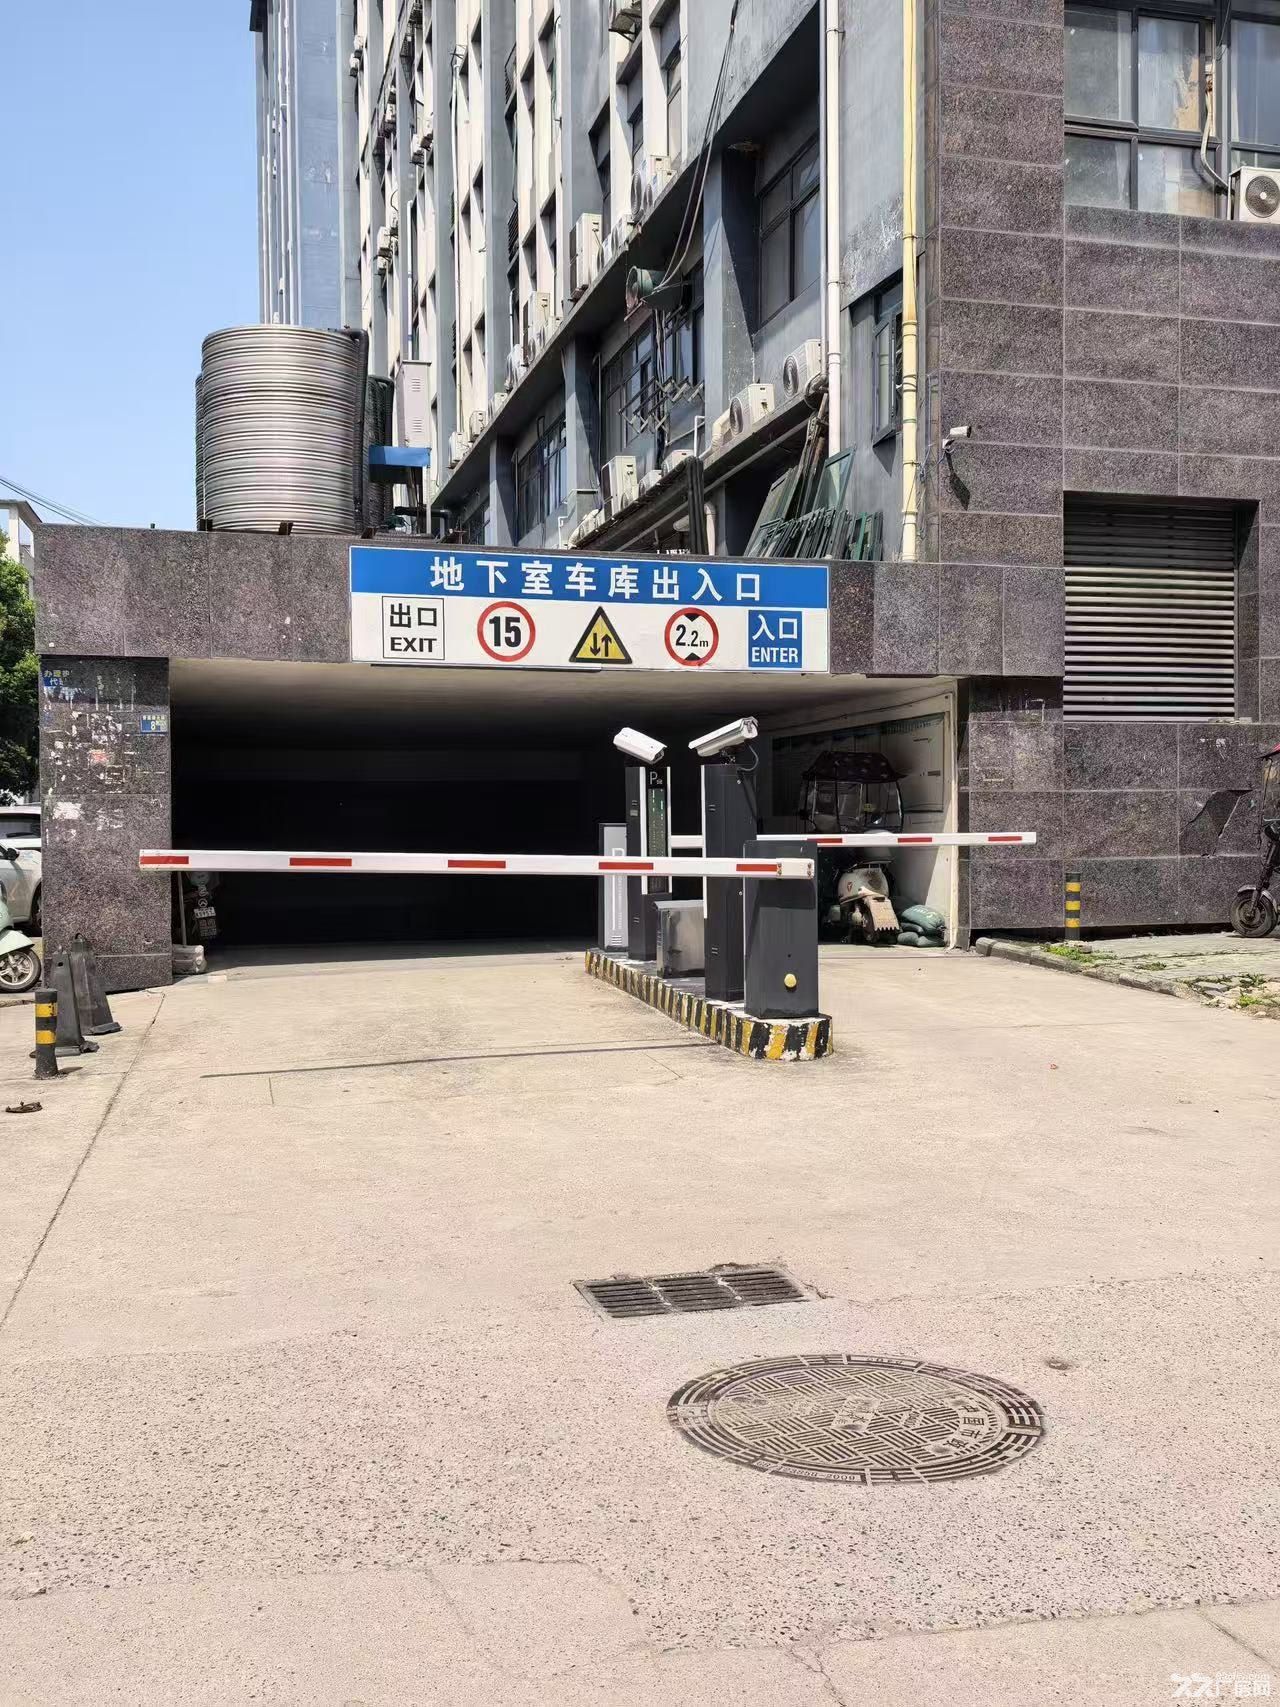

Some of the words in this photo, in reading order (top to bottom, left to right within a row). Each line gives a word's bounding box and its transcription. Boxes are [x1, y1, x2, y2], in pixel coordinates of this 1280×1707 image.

[430, 556, 761, 601] 地下室车库出入口
[389, 603, 437, 629] 出口
[752, 615, 799, 641] 入口
[390, 636, 438, 653] EXIT
[488, 616, 522, 648] 15
[675, 624, 709, 649] 2.2m
[751, 646, 799, 663] ENTER
[650, 771, 658, 785] P
